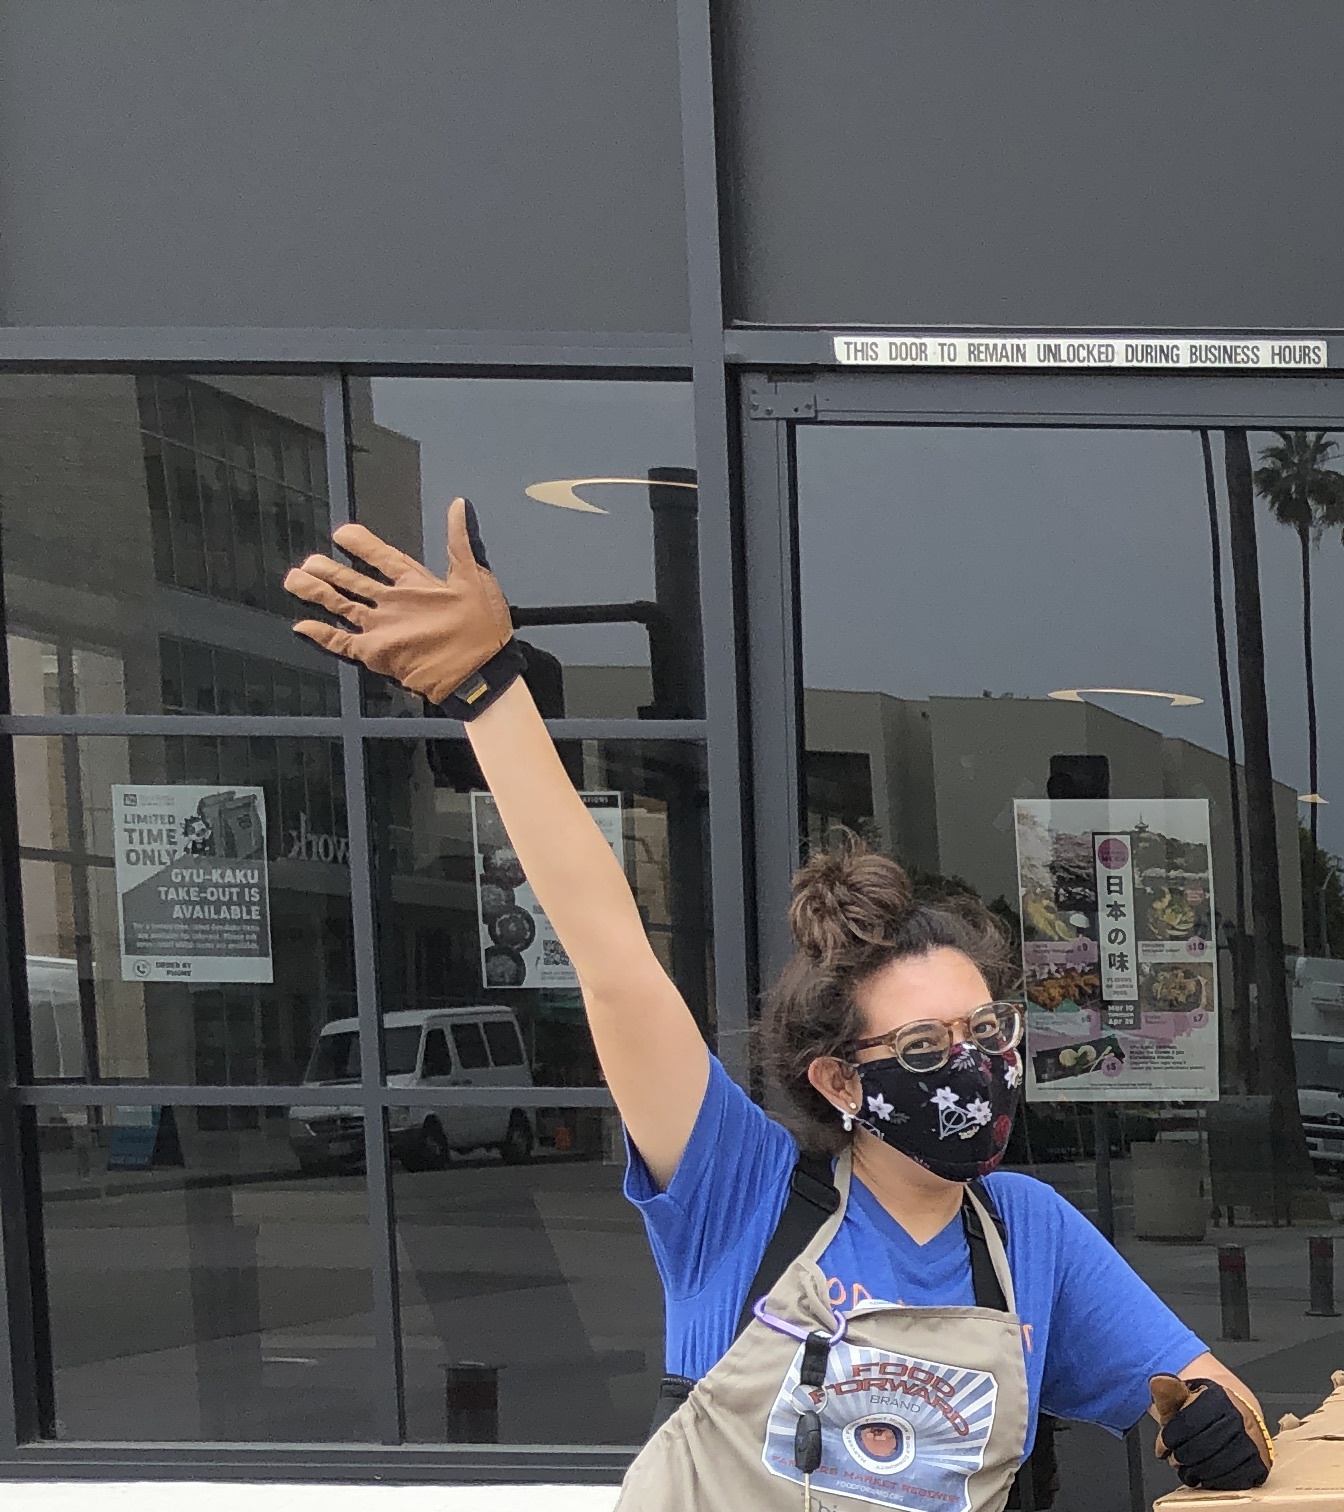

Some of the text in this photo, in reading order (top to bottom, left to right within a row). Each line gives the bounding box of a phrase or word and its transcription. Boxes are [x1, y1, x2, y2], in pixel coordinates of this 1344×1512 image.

[844, 341, 1322, 366] THIS DOOR TO REMAIN UNLOCKED DURING BUSINESS HOURS
[124, 814, 176, 826] LIMITED
[124, 828, 178, 846] TIME
[126, 849, 178, 866] ONLY
[171, 868, 259, 884] GYU-KAKU
[158, 886, 260, 902] TAKE-OUT IS
[172, 904, 261, 920] AVAILABLE
[1106, 876, 1130, 973] 日本の味
[852, 1362, 956, 1398] FOOD
[809, 1378, 970, 1436] FORWARD
[870, 1395, 920, 1414] BRAND
